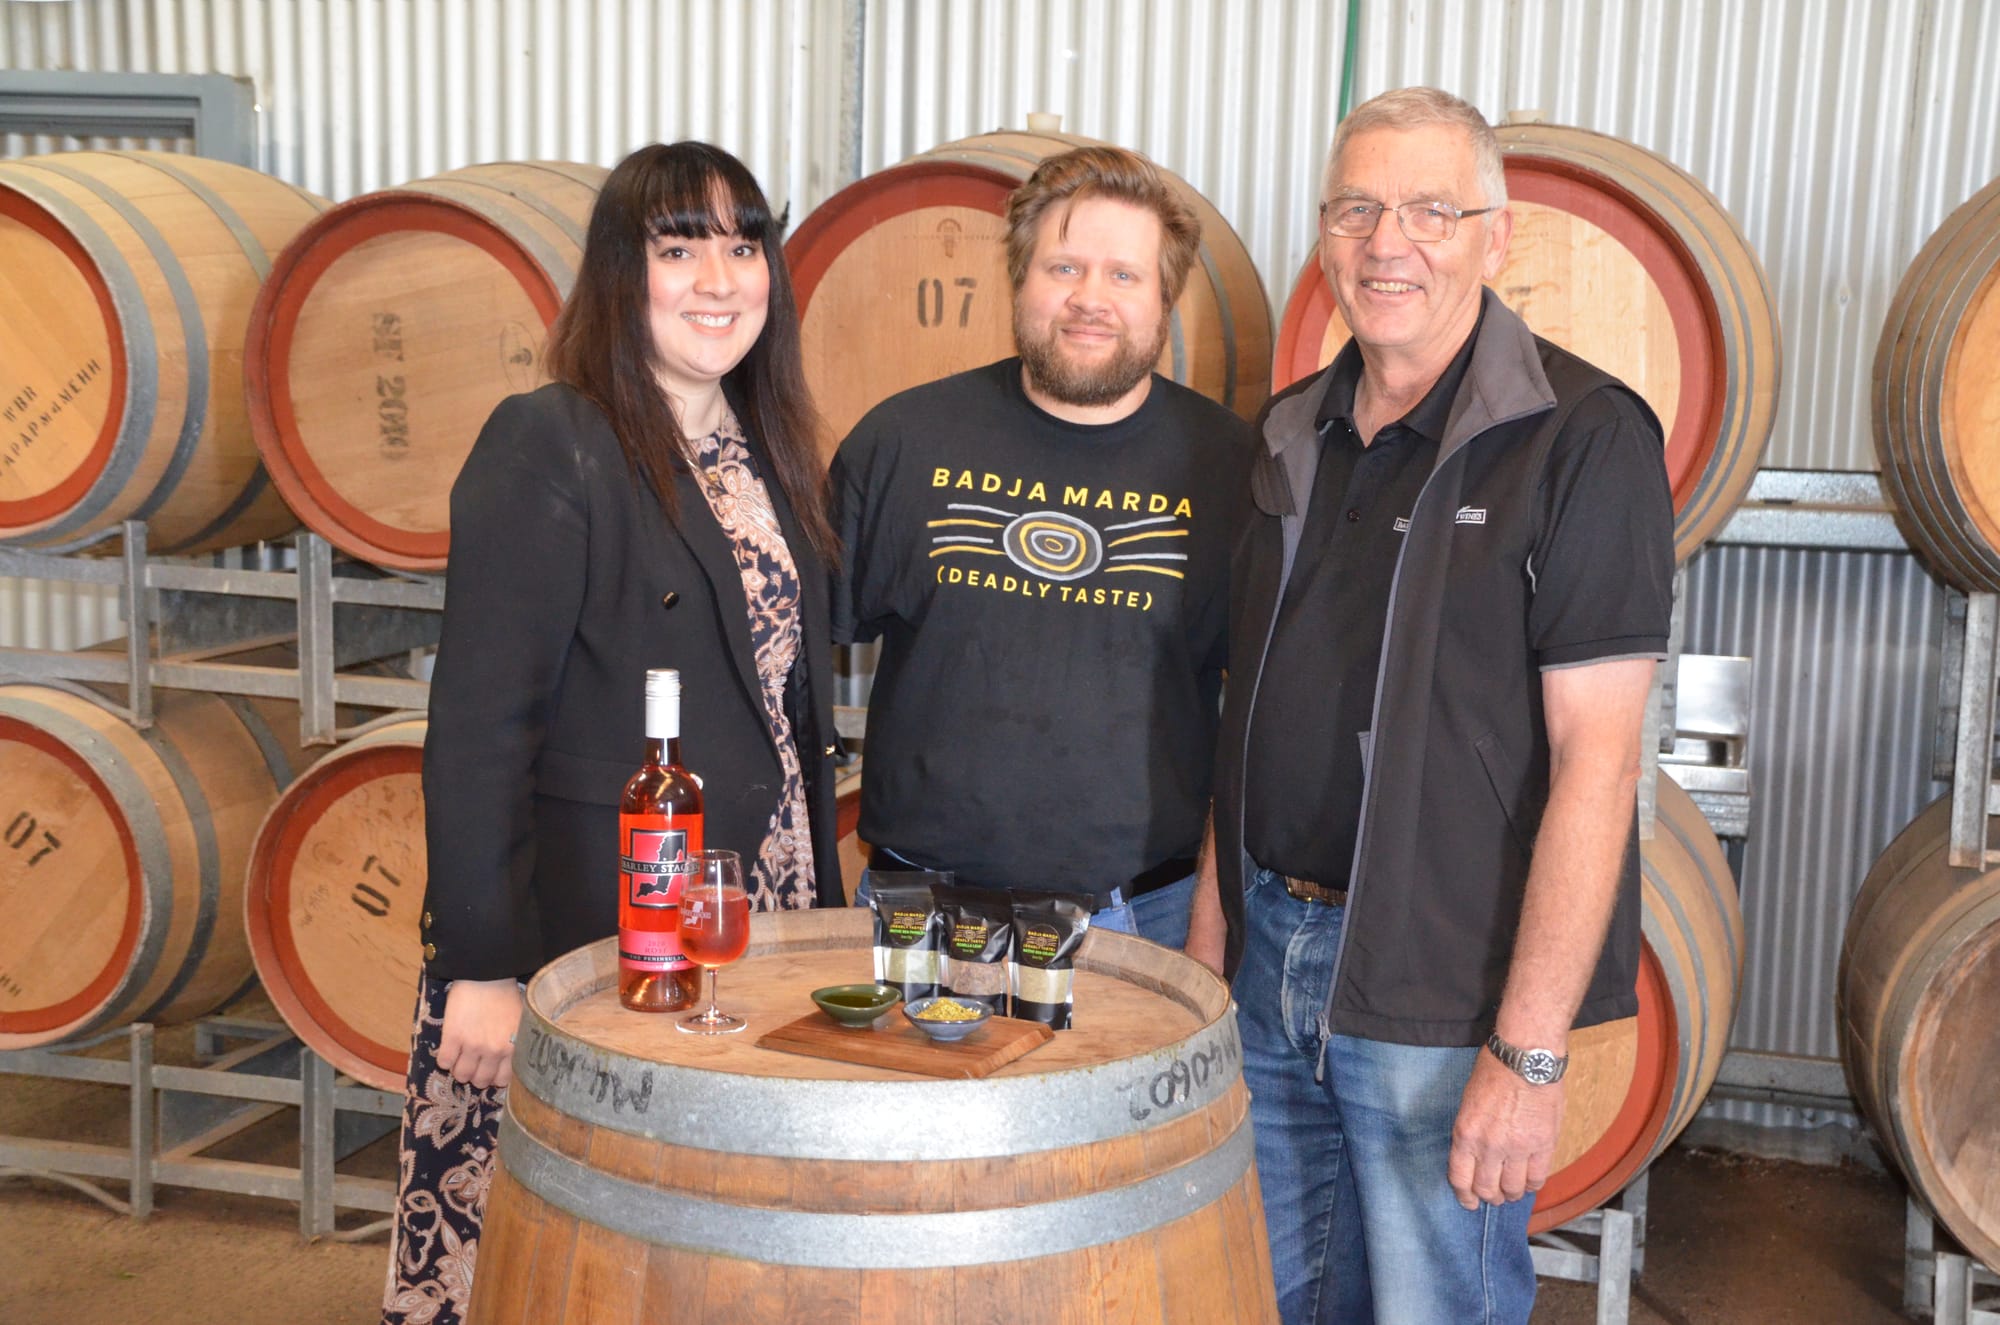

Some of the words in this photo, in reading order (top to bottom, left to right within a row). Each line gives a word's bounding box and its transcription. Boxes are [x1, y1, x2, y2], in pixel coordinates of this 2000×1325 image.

[917, 277, 977, 328] 07
[931, 467, 1047, 502] BADJA
[1063, 486, 1192, 518] MARDA
[936, 564, 1051, 598] (DEADLY
[1059, 586, 1152, 611] TASTE)
[4, 811, 62, 867] 07
[351, 854, 401, 918] 07
